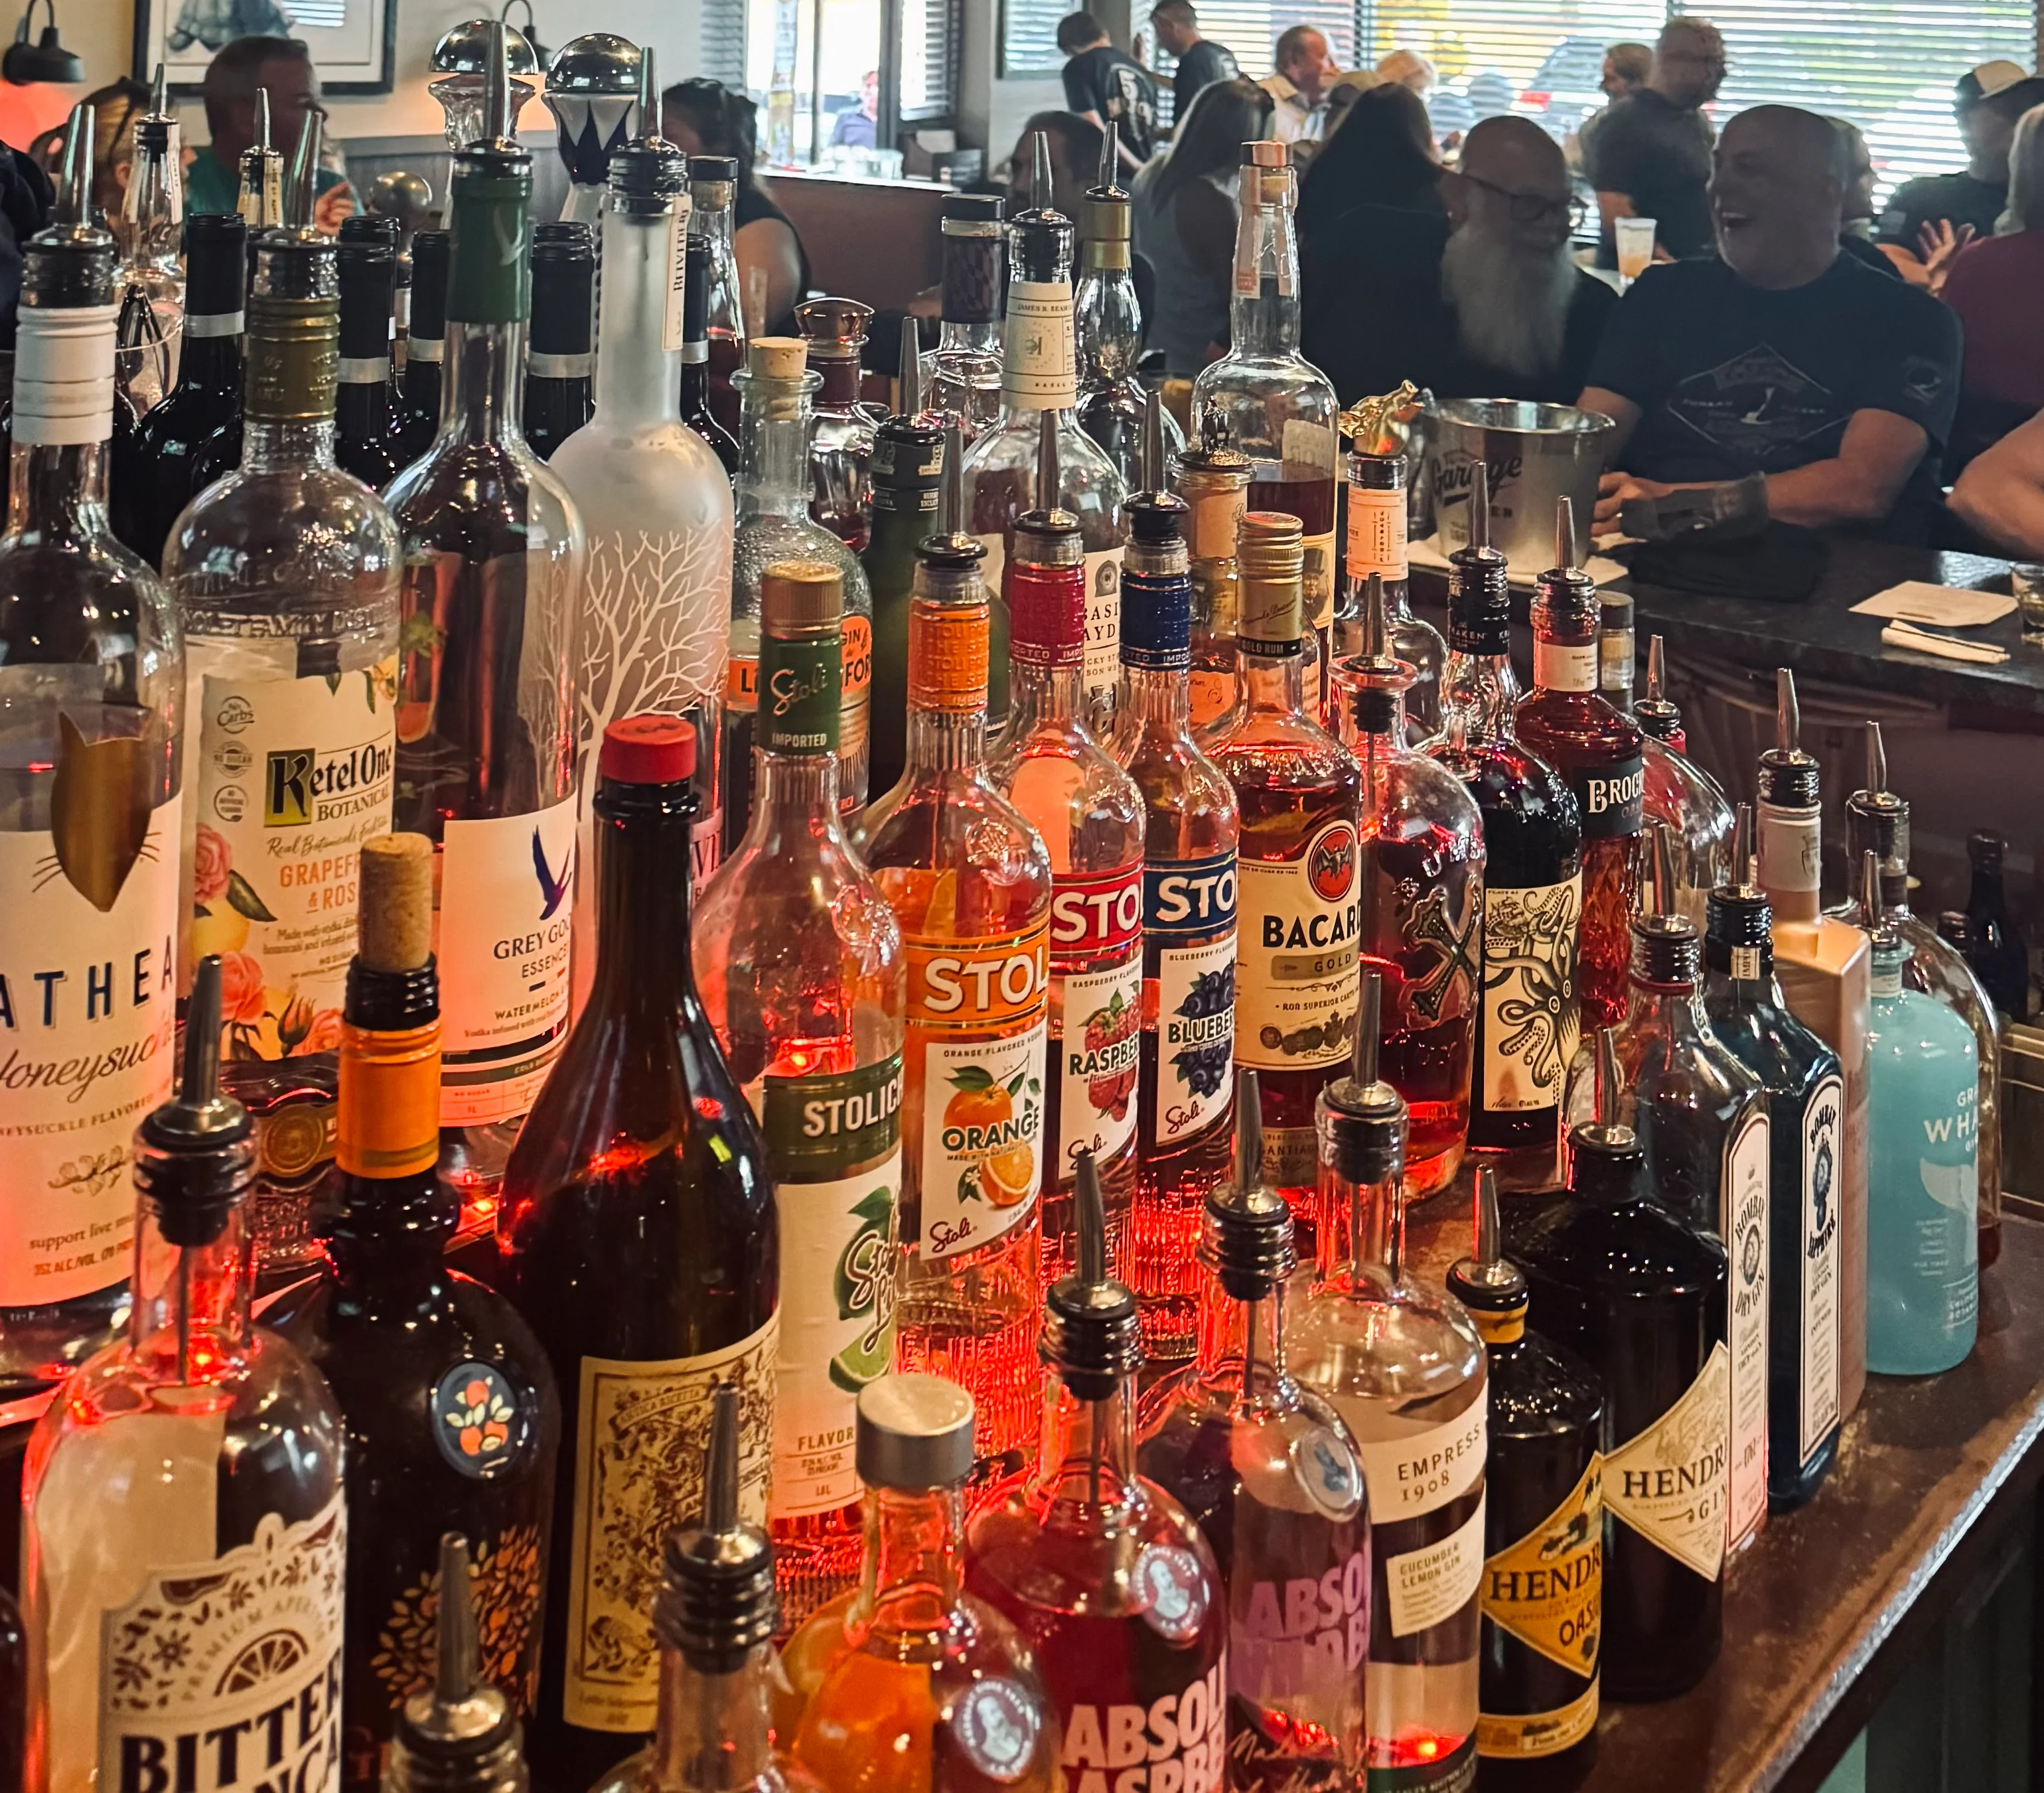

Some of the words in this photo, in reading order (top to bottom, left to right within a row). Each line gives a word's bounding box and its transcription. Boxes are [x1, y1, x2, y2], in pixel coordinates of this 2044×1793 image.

[1264, 644, 1284, 655] RUM
[770, 662, 828, 716] Stoli
[772, 733, 828, 748] IMPORTED
[270, 751, 357, 817] Ketel
[323, 881, 356, 910] ROS
[493, 929, 546, 960] GREY
[1169, 950, 1214, 962] BLUEBERRY
[924, 944, 1049, 1013] STOL
[1314, 953, 1352, 973] GOLD
[1072, 975, 1118, 988] RASPBERRY
[1303, 996, 1339, 1011] SUPERIOR
[944, 1049, 982, 1058] ORANGE
[986, 1039, 1025, 1055] FLAVORED
[942, 1105, 1040, 1152] ORANGE
[1165, 1100, 1202, 1135] Stoli
[1810, 1104, 1837, 1153] BOMBAY
[29, 1230, 86, 1252] support
[89, 1219, 113, 1238] live
[929, 1217, 973, 1253] Stoli
[1735, 1195, 1765, 1246] BOMBAY
[1735, 1289, 1751, 1317] DRY
[1752, 1267, 1765, 1306] GIN
[798, 1426, 854, 1451] FLAVOR
[1398, 1422, 1481, 1481] EMPRESS
[1401, 1472, 1451, 1502] 1908
[1622, 1443, 1724, 1499] HENDR
[1400, 1541, 1459, 1577] CUCUMBER
[1402, 1567, 1441, 1590] LEMON
[1443, 1555, 1461, 1572] GIN
